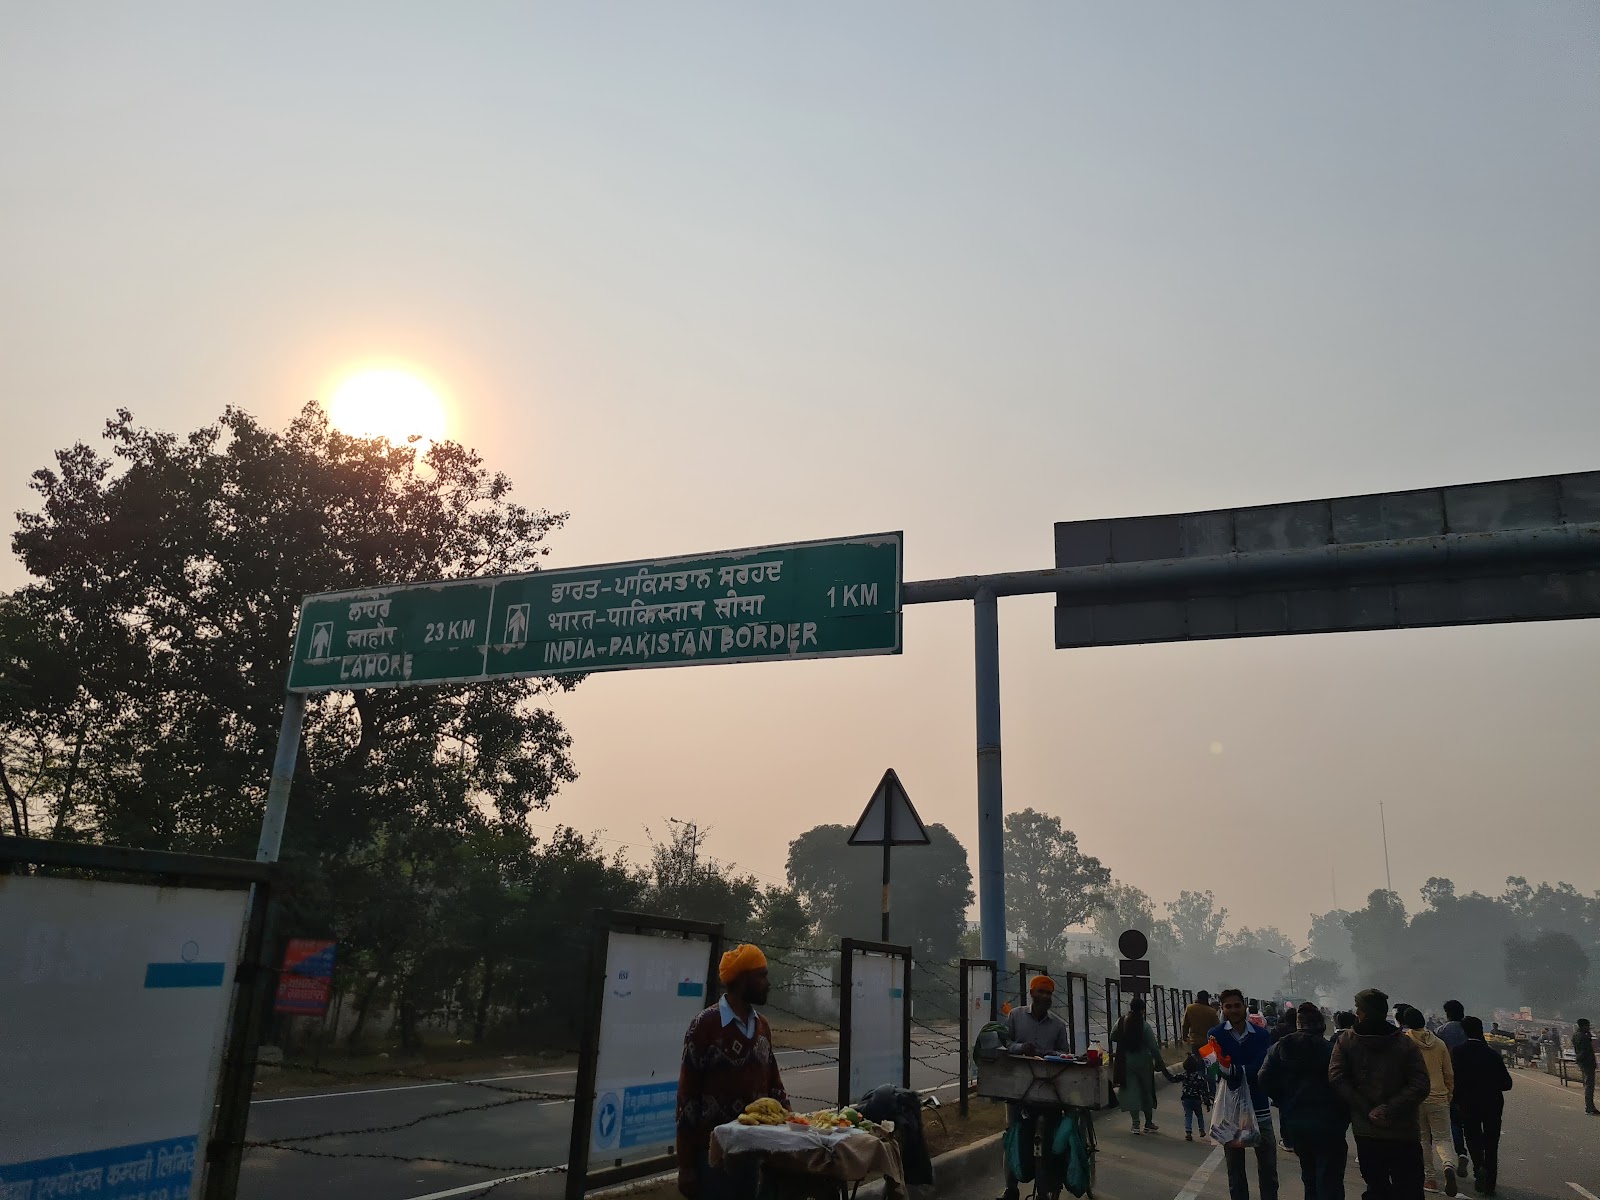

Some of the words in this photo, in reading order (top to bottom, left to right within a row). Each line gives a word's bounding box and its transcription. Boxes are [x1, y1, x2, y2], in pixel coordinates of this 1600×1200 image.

[713, 589, 766, 620] सीमा
[843, 583, 878, 608] KM
[346, 619, 398, 650] लाहौर
[424, 622, 445, 643] 23
[448, 619, 476, 640] KM
[543, 629, 713, 664] INDIA-PAKISTAN
[720, 622, 818, 654] BORDER
[340, 653, 414, 681] LAHORE
